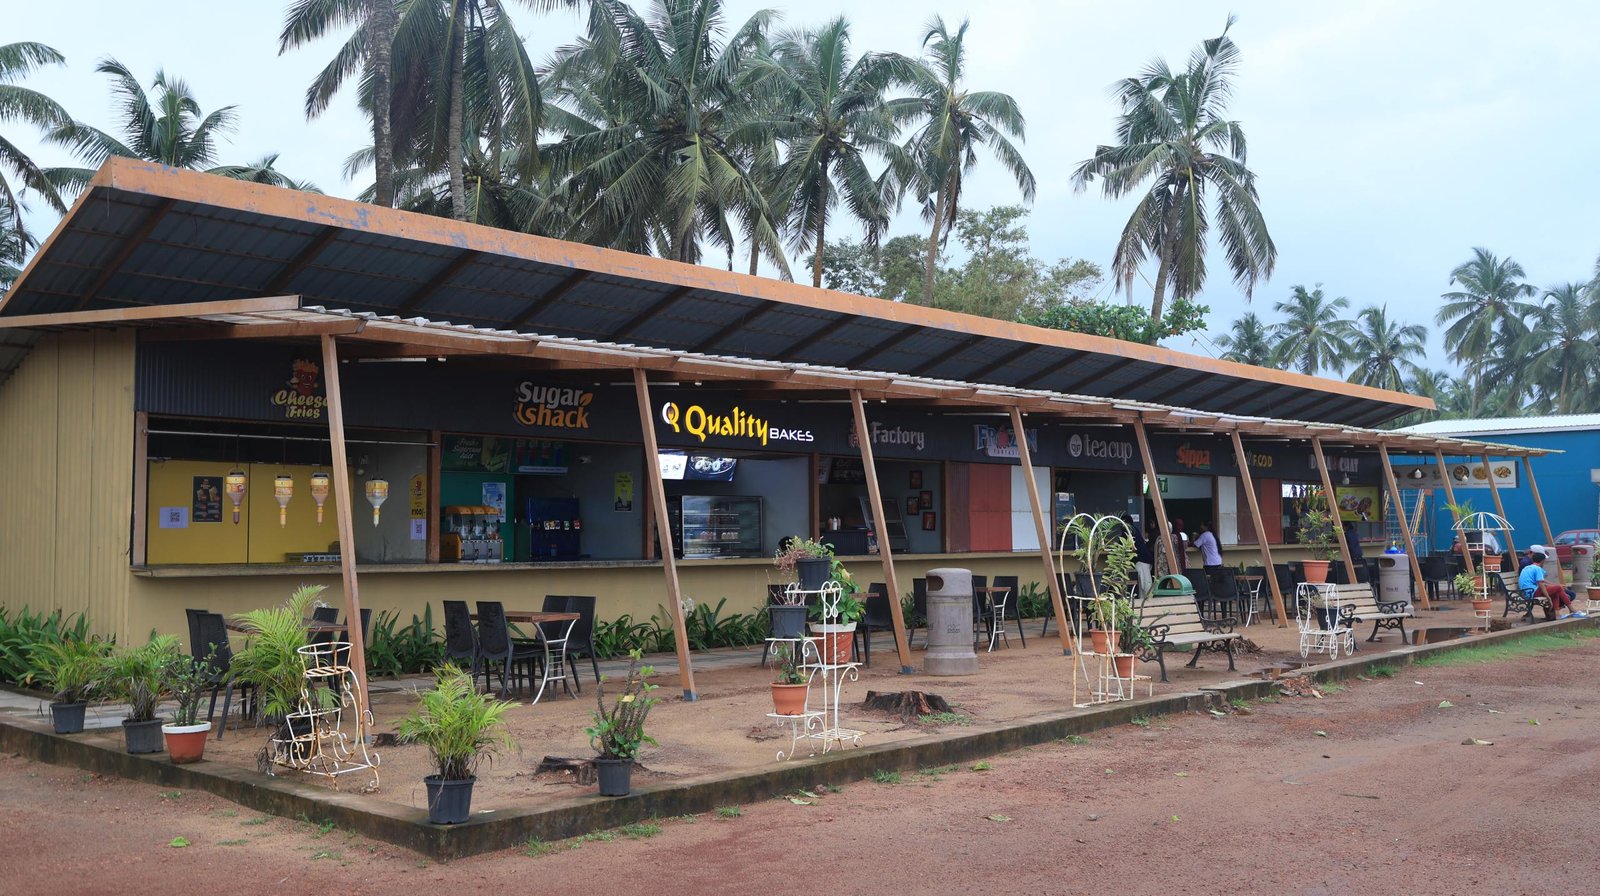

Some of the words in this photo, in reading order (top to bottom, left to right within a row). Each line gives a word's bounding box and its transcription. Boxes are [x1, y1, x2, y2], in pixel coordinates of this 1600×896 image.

[516, 381, 583, 409] Sugar
[288, 405, 321, 419] Fries
[685, 404, 768, 446] Quality
[769, 427, 814, 442] BAKES
[871, 420, 924, 451] Factory
[975, 423, 1040, 453] FROZN
[1177, 446, 1211, 468] Sippa
[1253, 453, 1273, 468] FOOD
[1338, 456, 1359, 473] CHAT
